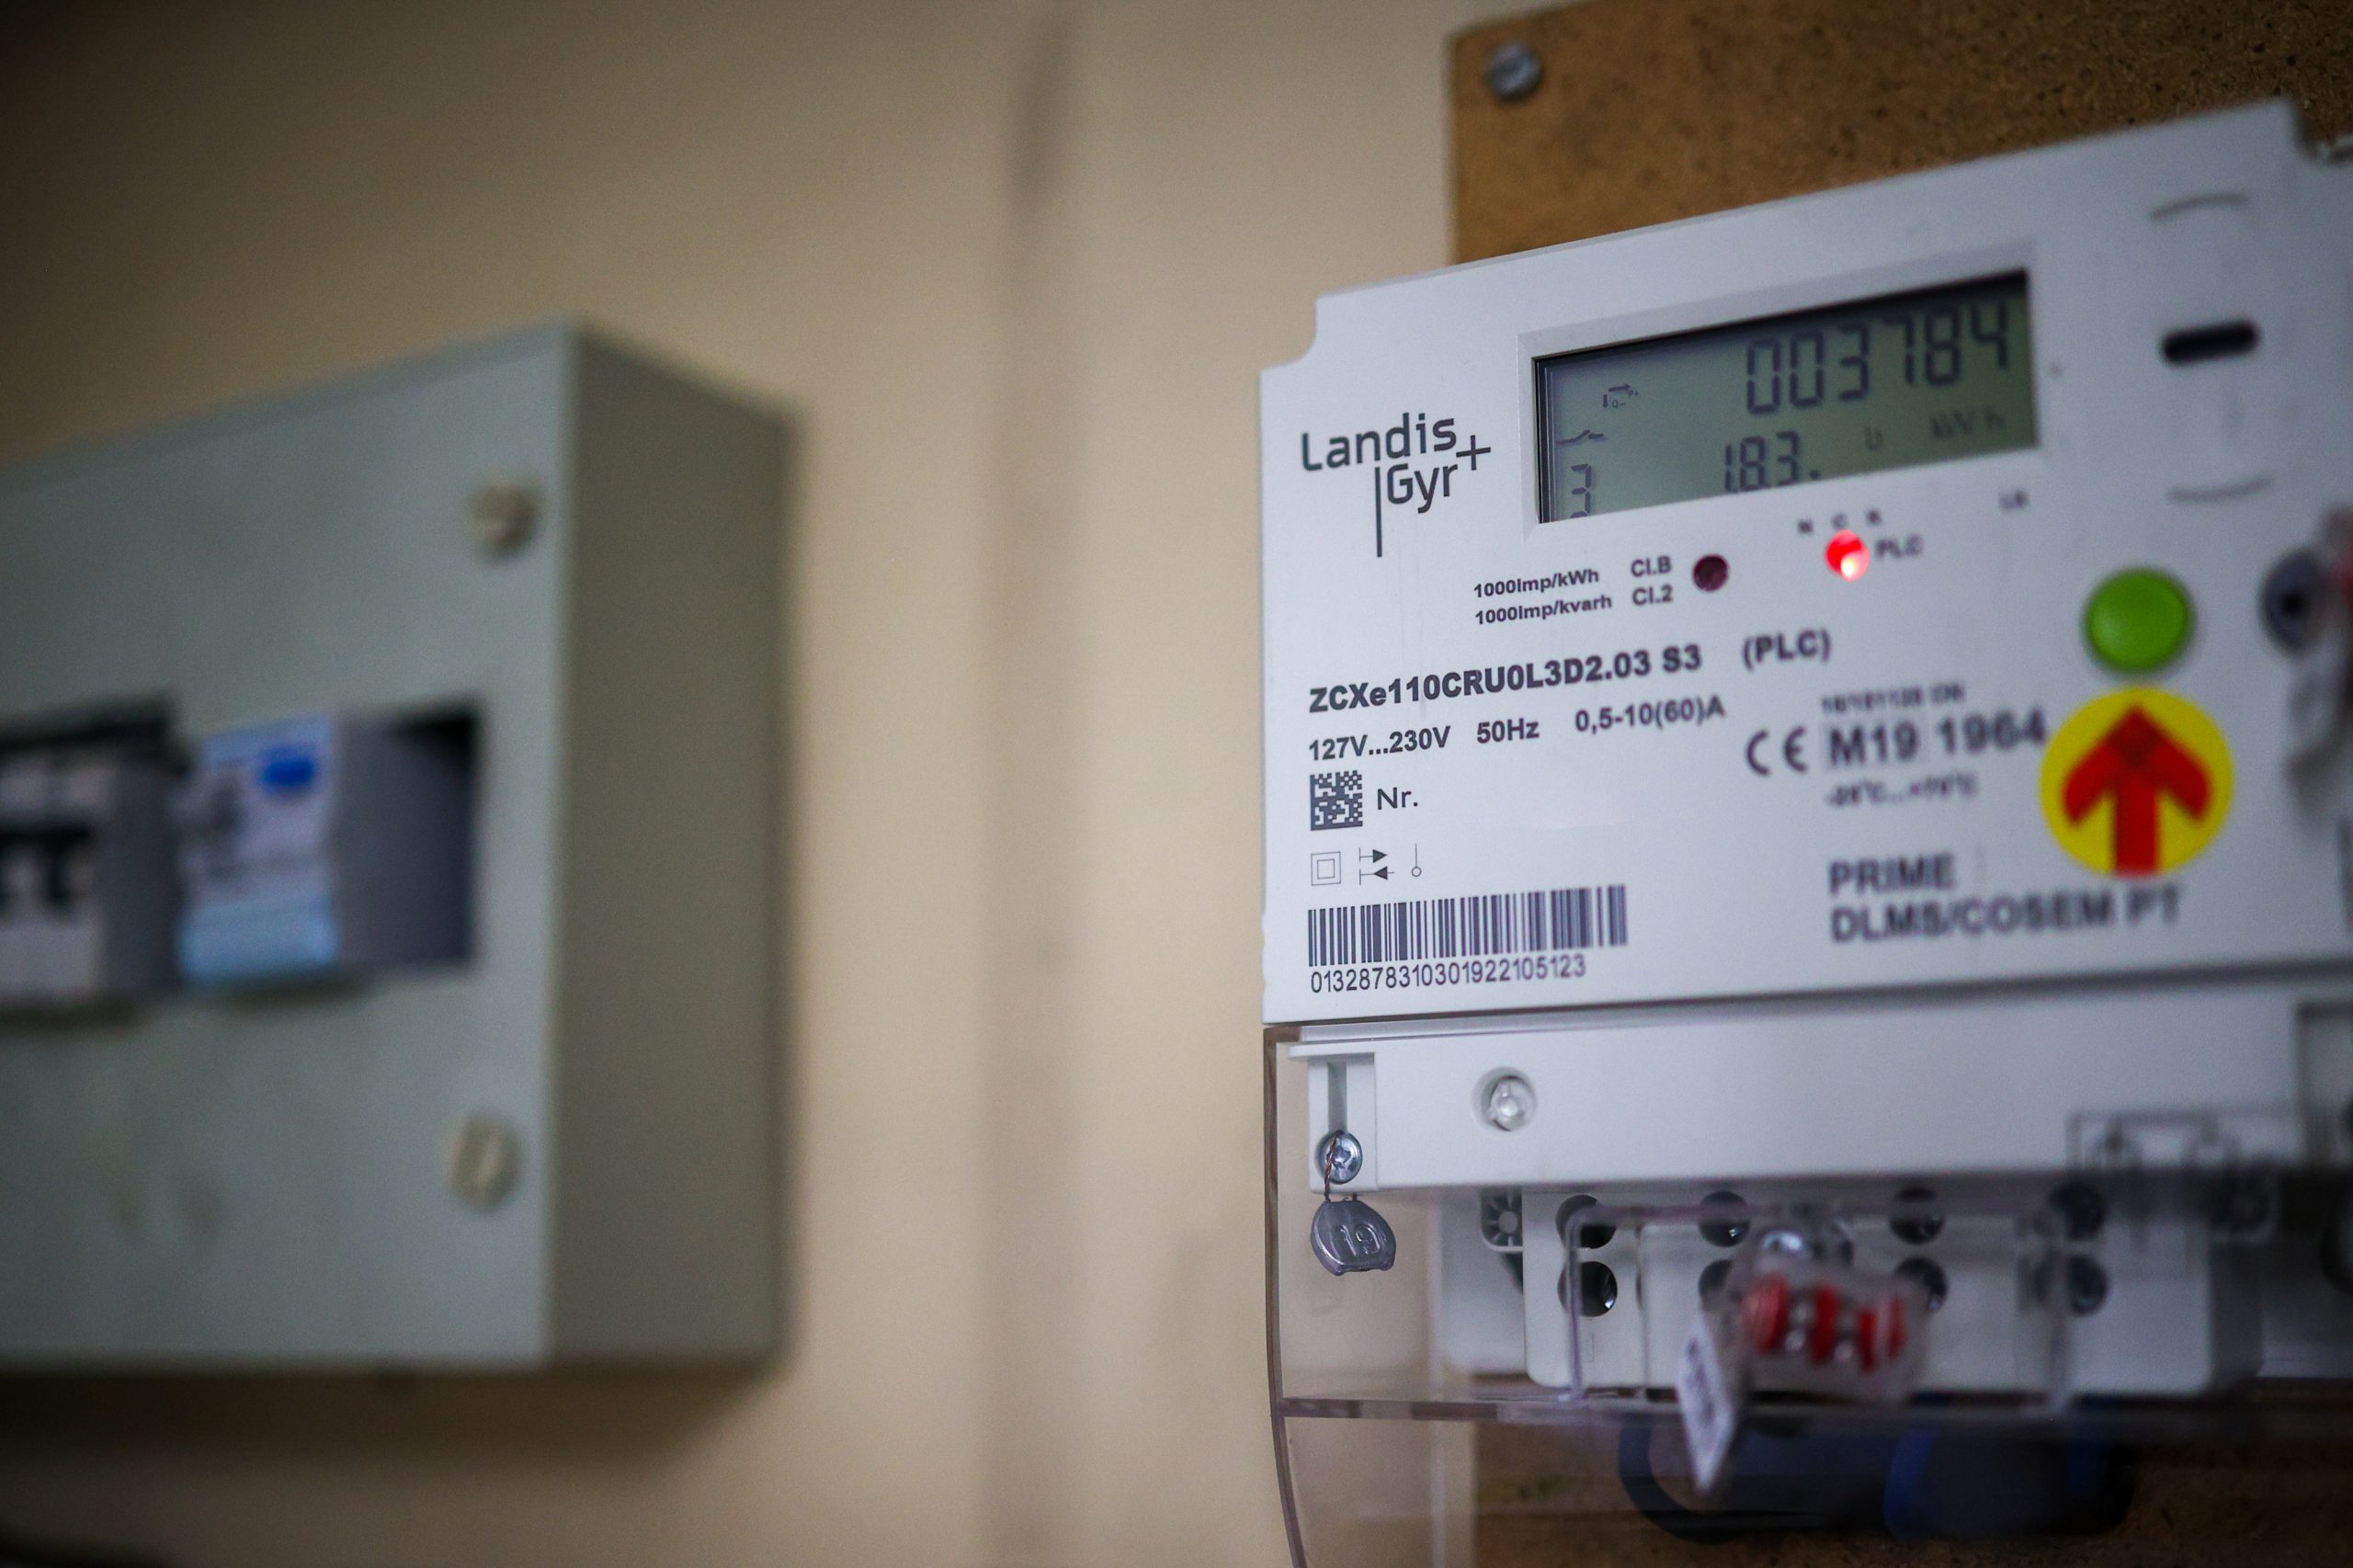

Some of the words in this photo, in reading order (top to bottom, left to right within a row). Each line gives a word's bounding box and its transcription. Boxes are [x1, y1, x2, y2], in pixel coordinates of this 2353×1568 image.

[1746, 301, 2010, 415] 003784
[1386, 463, 1459, 514] Gyr
[1662, 643, 1703, 674] S3
[1742, 628, 1833, 669] (PLC)
[1308, 725, 1451, 761] 127V...230V
[1475, 718, 1540, 744] 50Hz
[1574, 695, 1726, 734] 0,5-10(60)A
[1828, 721, 1920, 767] M19
[1377, 787, 1419, 810] Nr.
[1829, 851, 1955, 895] PRIME
[1830, 889, 2112, 943] DLMS/COSEM
[1311, 952, 1587, 994] 0132878310301922105123
